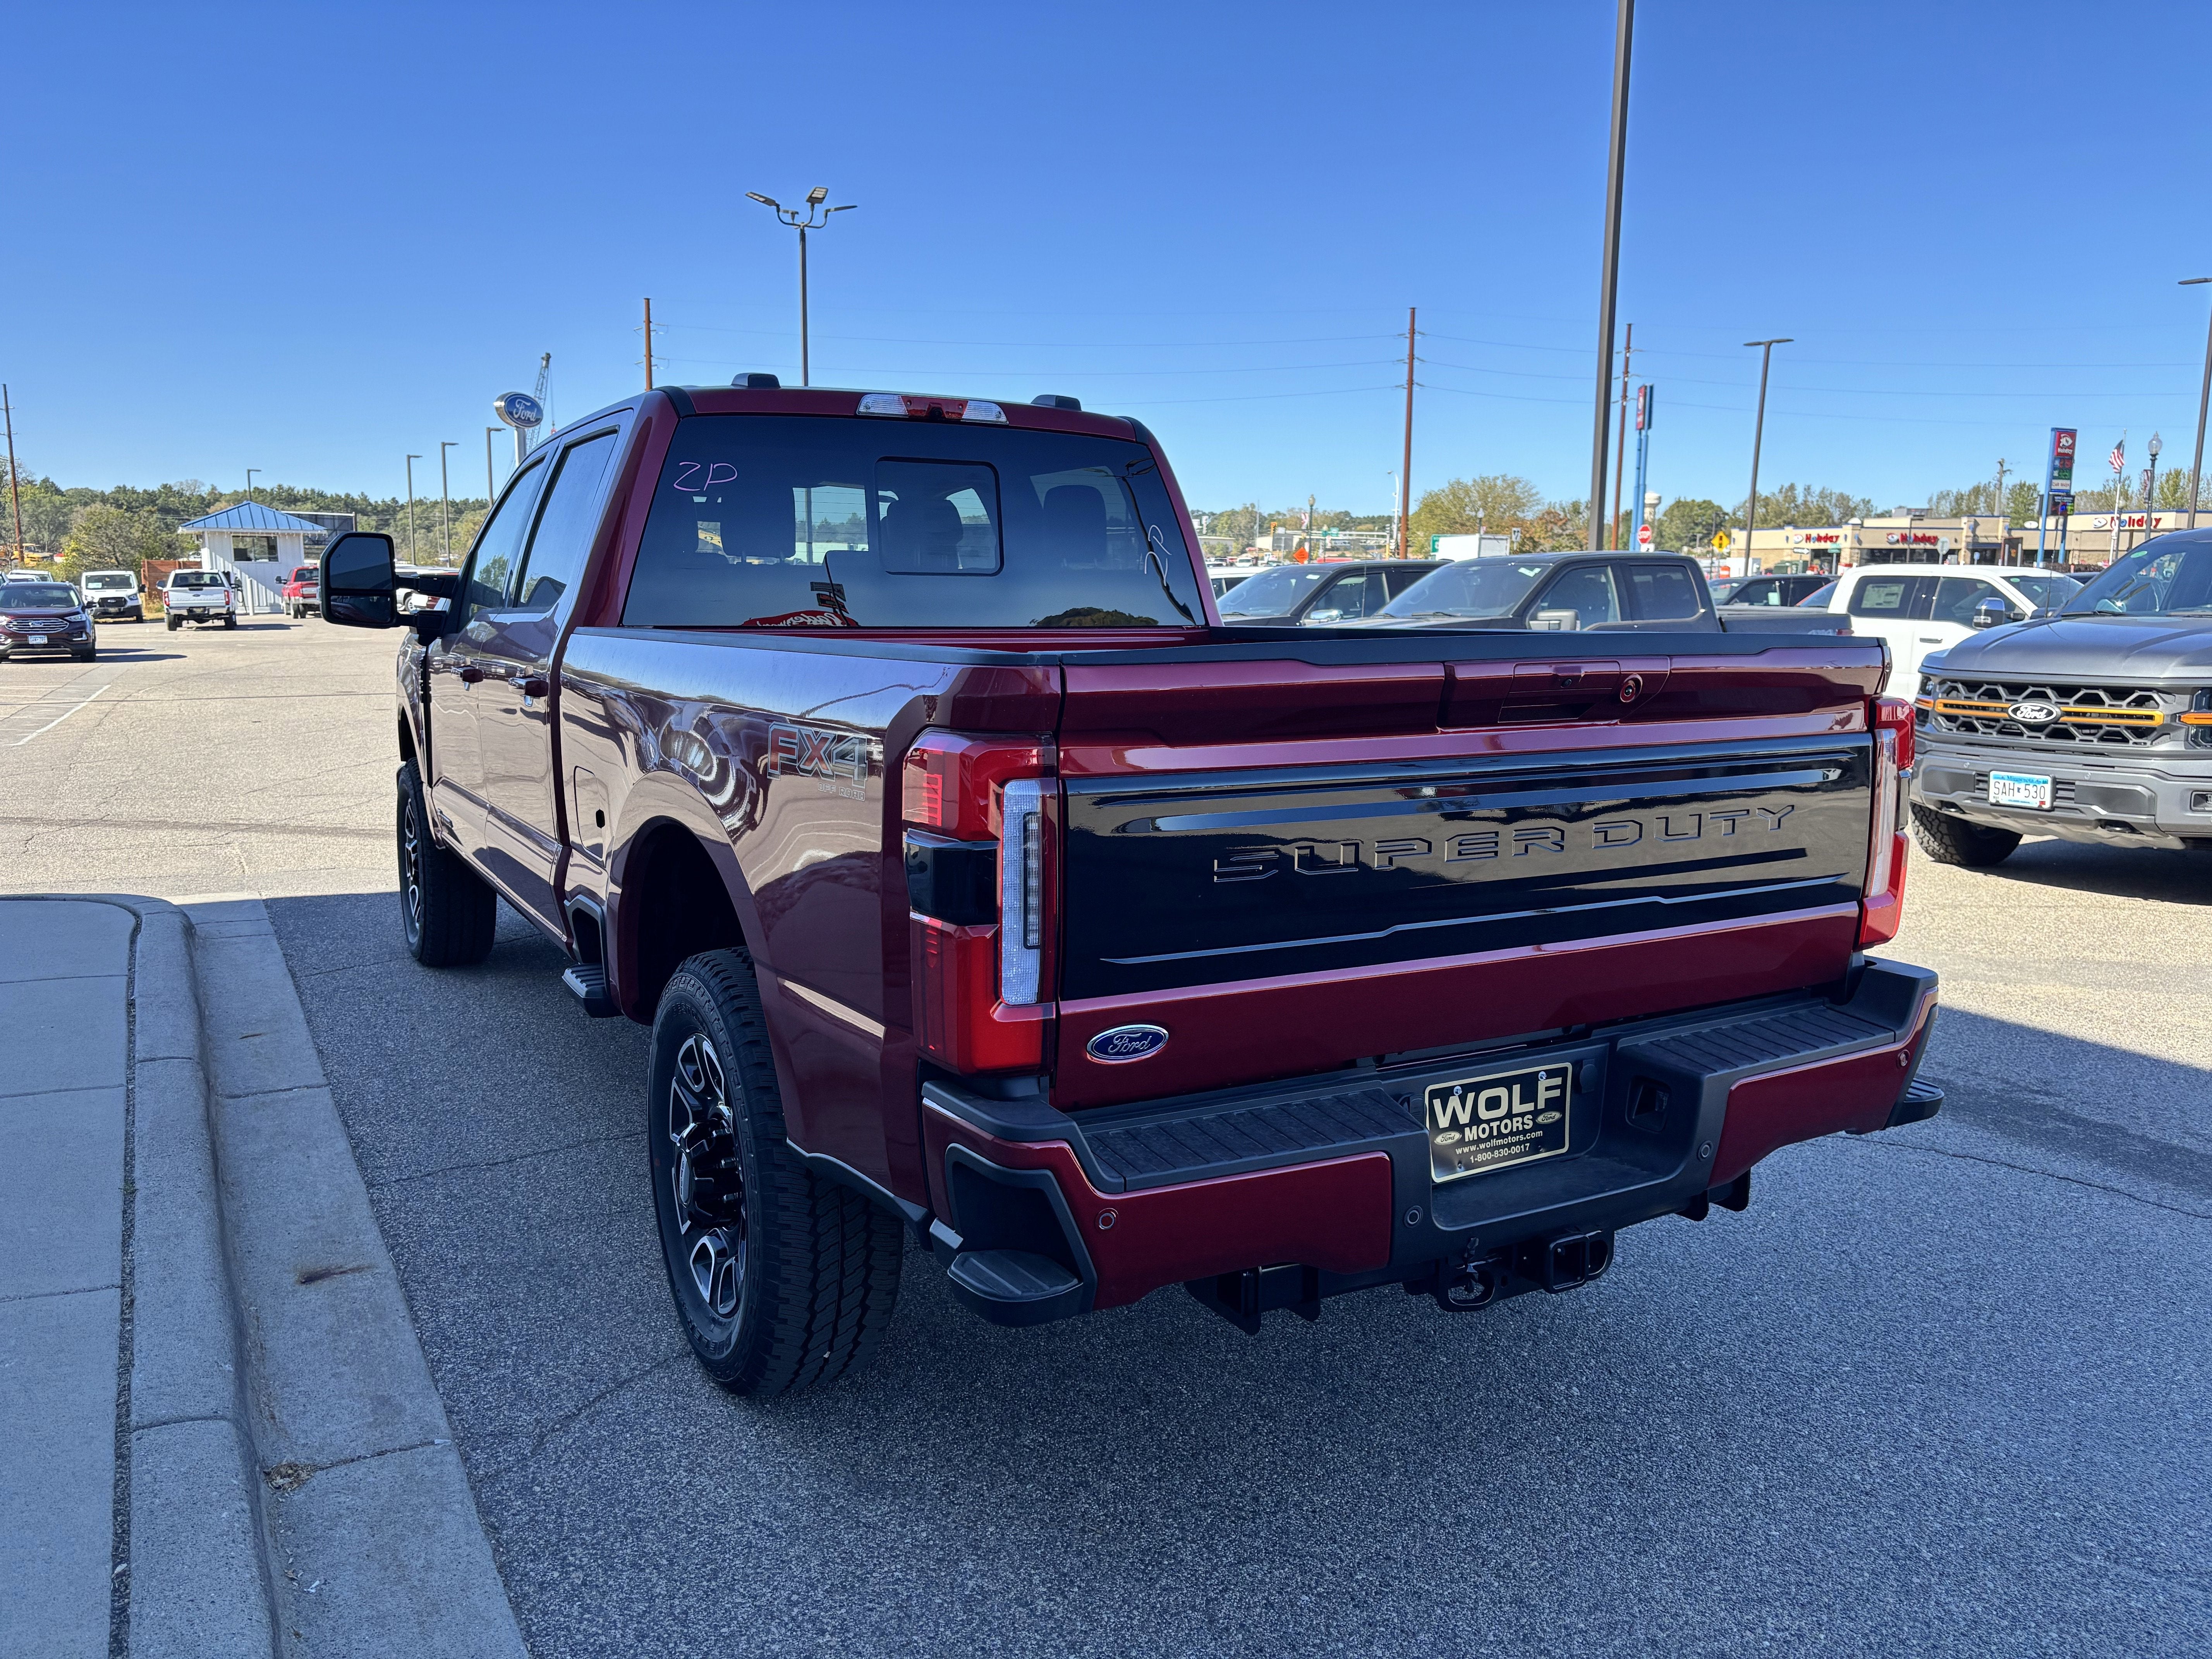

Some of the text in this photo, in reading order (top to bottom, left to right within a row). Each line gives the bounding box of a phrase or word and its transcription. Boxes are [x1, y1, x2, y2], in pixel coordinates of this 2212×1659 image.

[513, 398, 537, 422] Ford
[2110, 515, 2162, 529] olidy
[1638, 531, 1650, 539] STOP
[2016, 705, 2048, 719] Ford
[767, 721, 868, 788] FX4
[818, 782, 866, 801] OFF ROAD
[1994, 781, 2045, 799] SAH 530
[1214, 805, 1795, 883] SUPER DUTY
[1108, 1033, 1152, 1053] Ford
[1433, 1077, 1562, 1129] WOLF
[1541, 1113, 1557, 1122] Ford
[1440, 1134, 1456, 1143] Ford
[1464, 1115, 1533, 1142] MOTORS
[1455, 1130, 1543, 1155] www.wolfmotors.com
[1470, 1143, 1530, 1163] 1-800-830-0017
